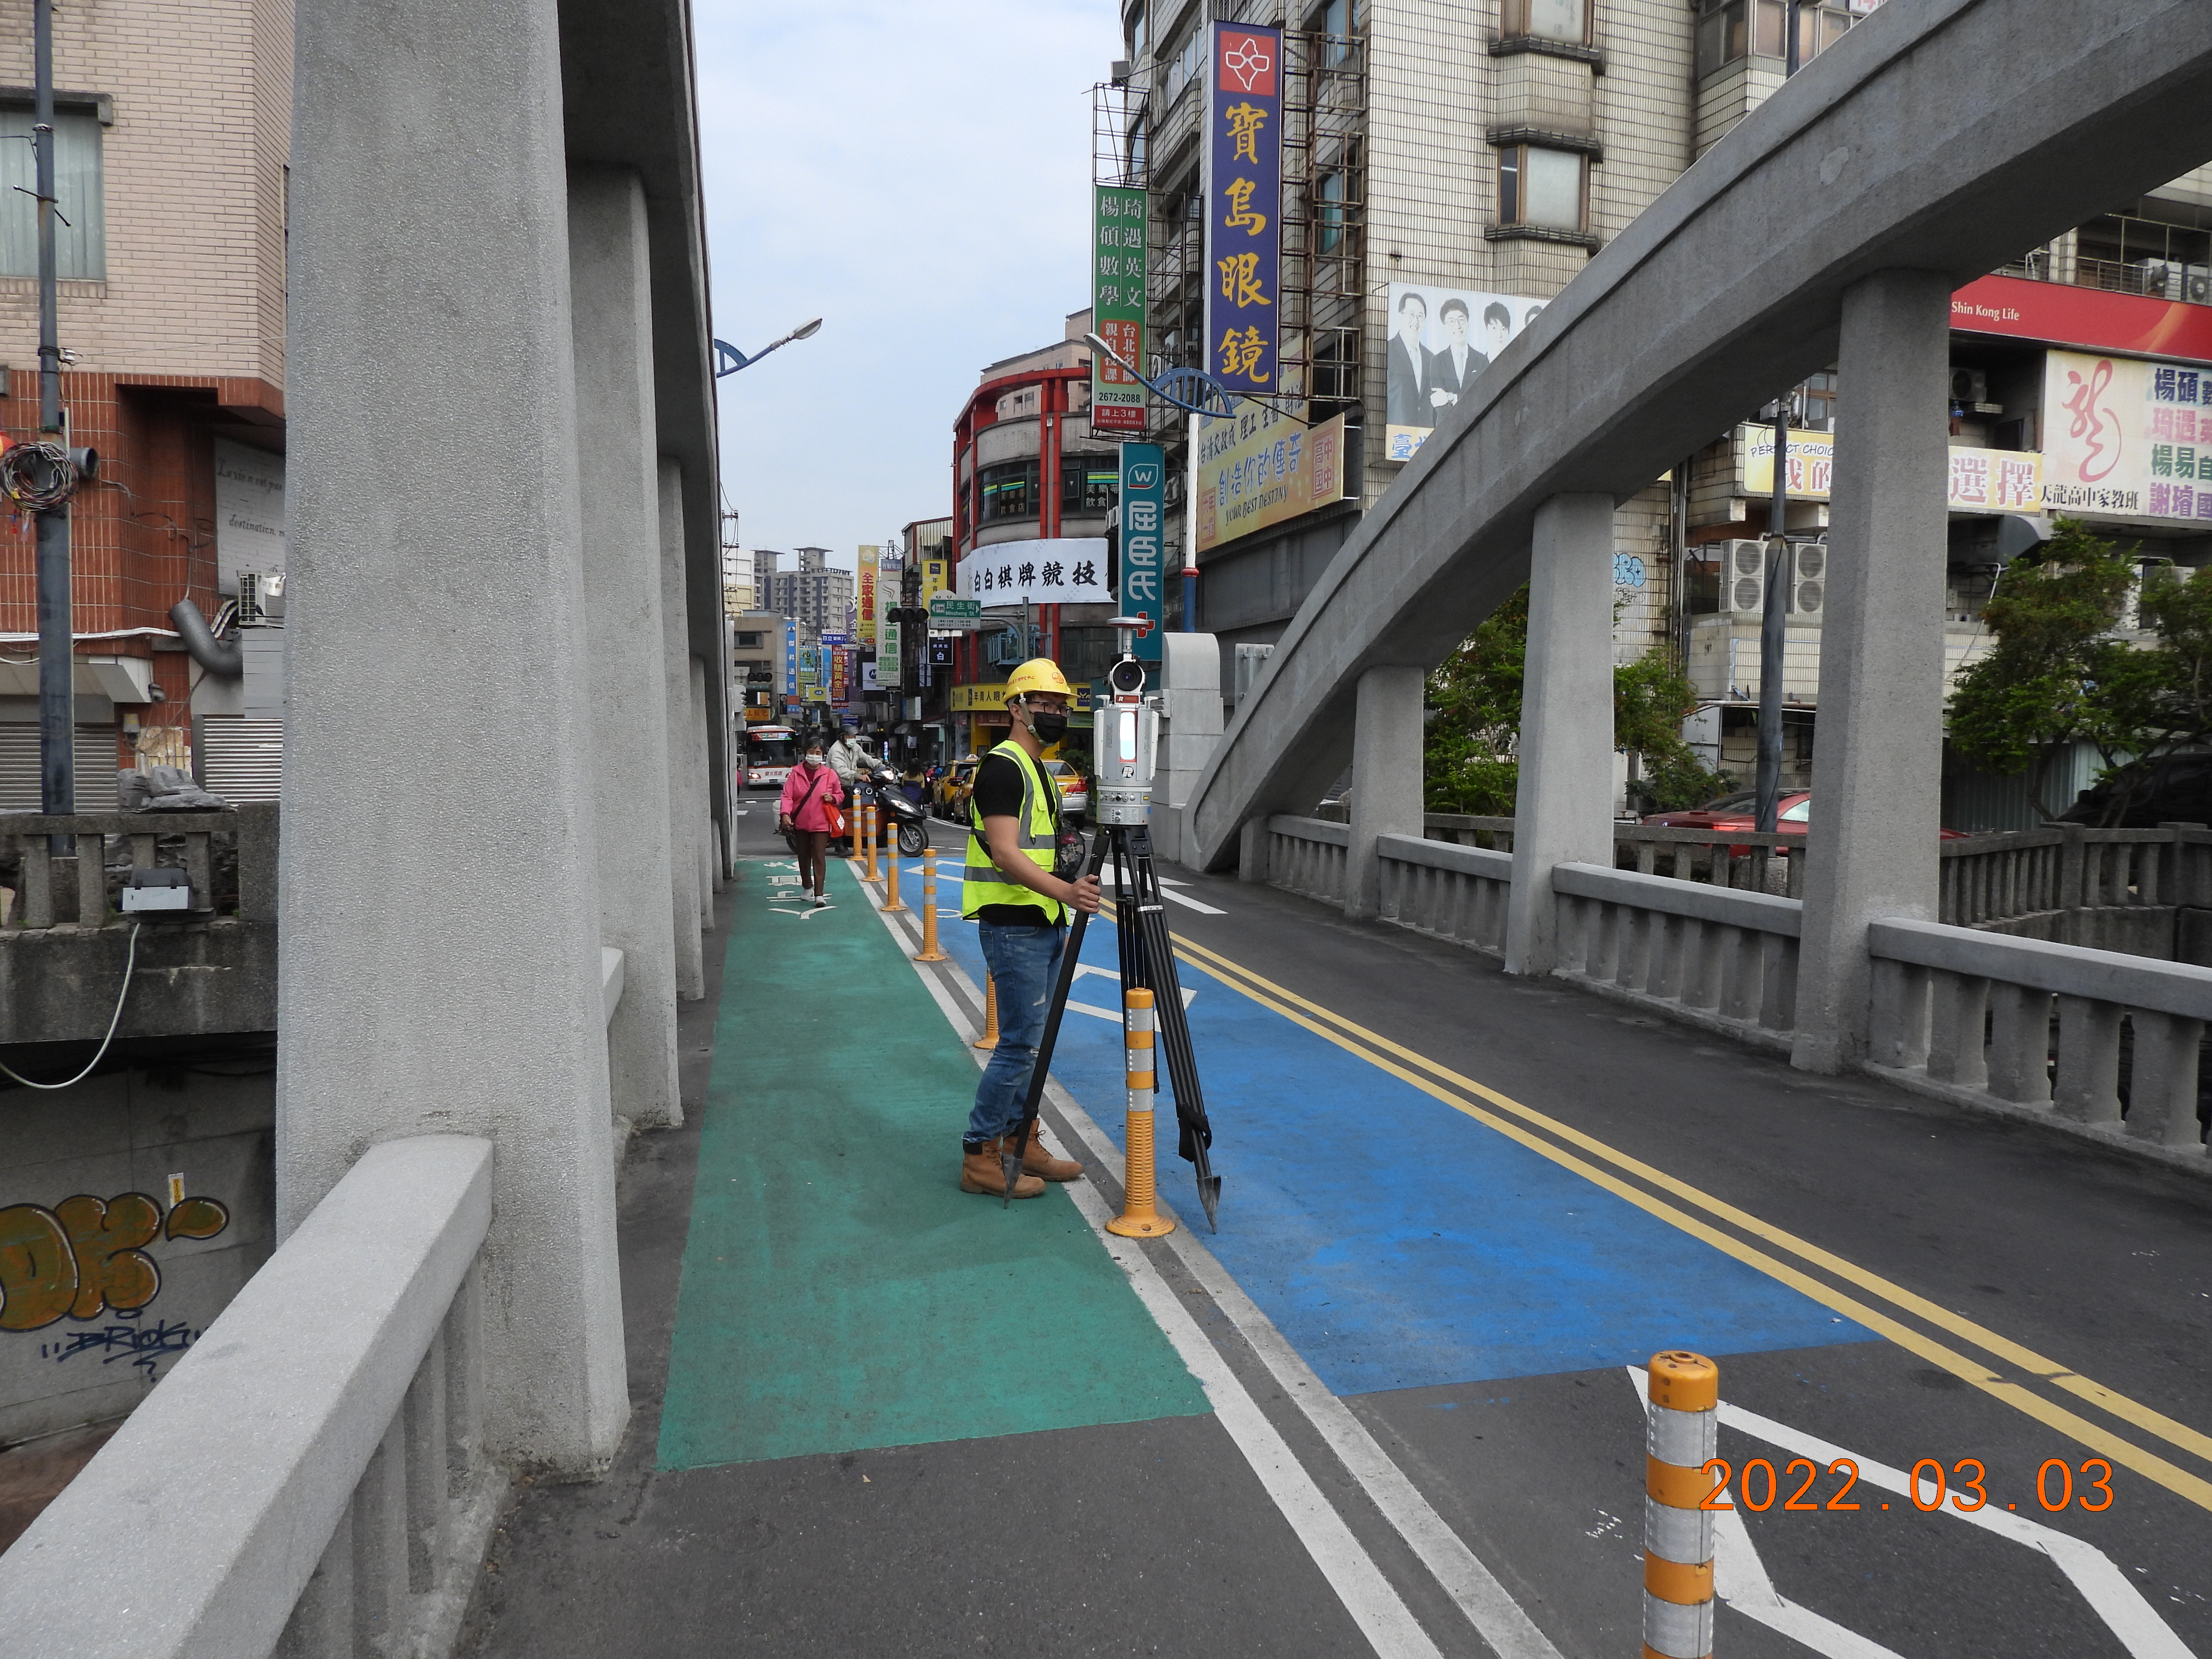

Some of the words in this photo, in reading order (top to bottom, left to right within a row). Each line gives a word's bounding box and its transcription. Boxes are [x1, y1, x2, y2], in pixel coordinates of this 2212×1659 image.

[1123, 198, 1142, 308] 琦遇英文
[1216, 102, 1272, 384] 寶島眼鏡
[1951, 301, 1973, 314] Shin
[1976, 304, 1999, 321] Kong
[2002, 308, 2020, 321] Life
[1099, 392, 1141, 403] 2672-2088
[1102, 409, 1136, 418] 請上3樓
[1315, 437, 1333, 465] 高中
[1751, 444, 1800, 457] PERCT
[1803, 445, 1835, 457] CHOIC
[1219, 432, 1302, 507] 創造你的傳奇
[1950, 456, 2033, 507] 選擇
[1242, 496, 1258, 518] BEST
[2040, 484, 2139, 510] 天龍高中家教班
[1128, 500, 1157, 601] 屈臣氏
[974, 560, 1098, 593] 白白棋牌競技
[946, 601, 975, 610] 民生街
